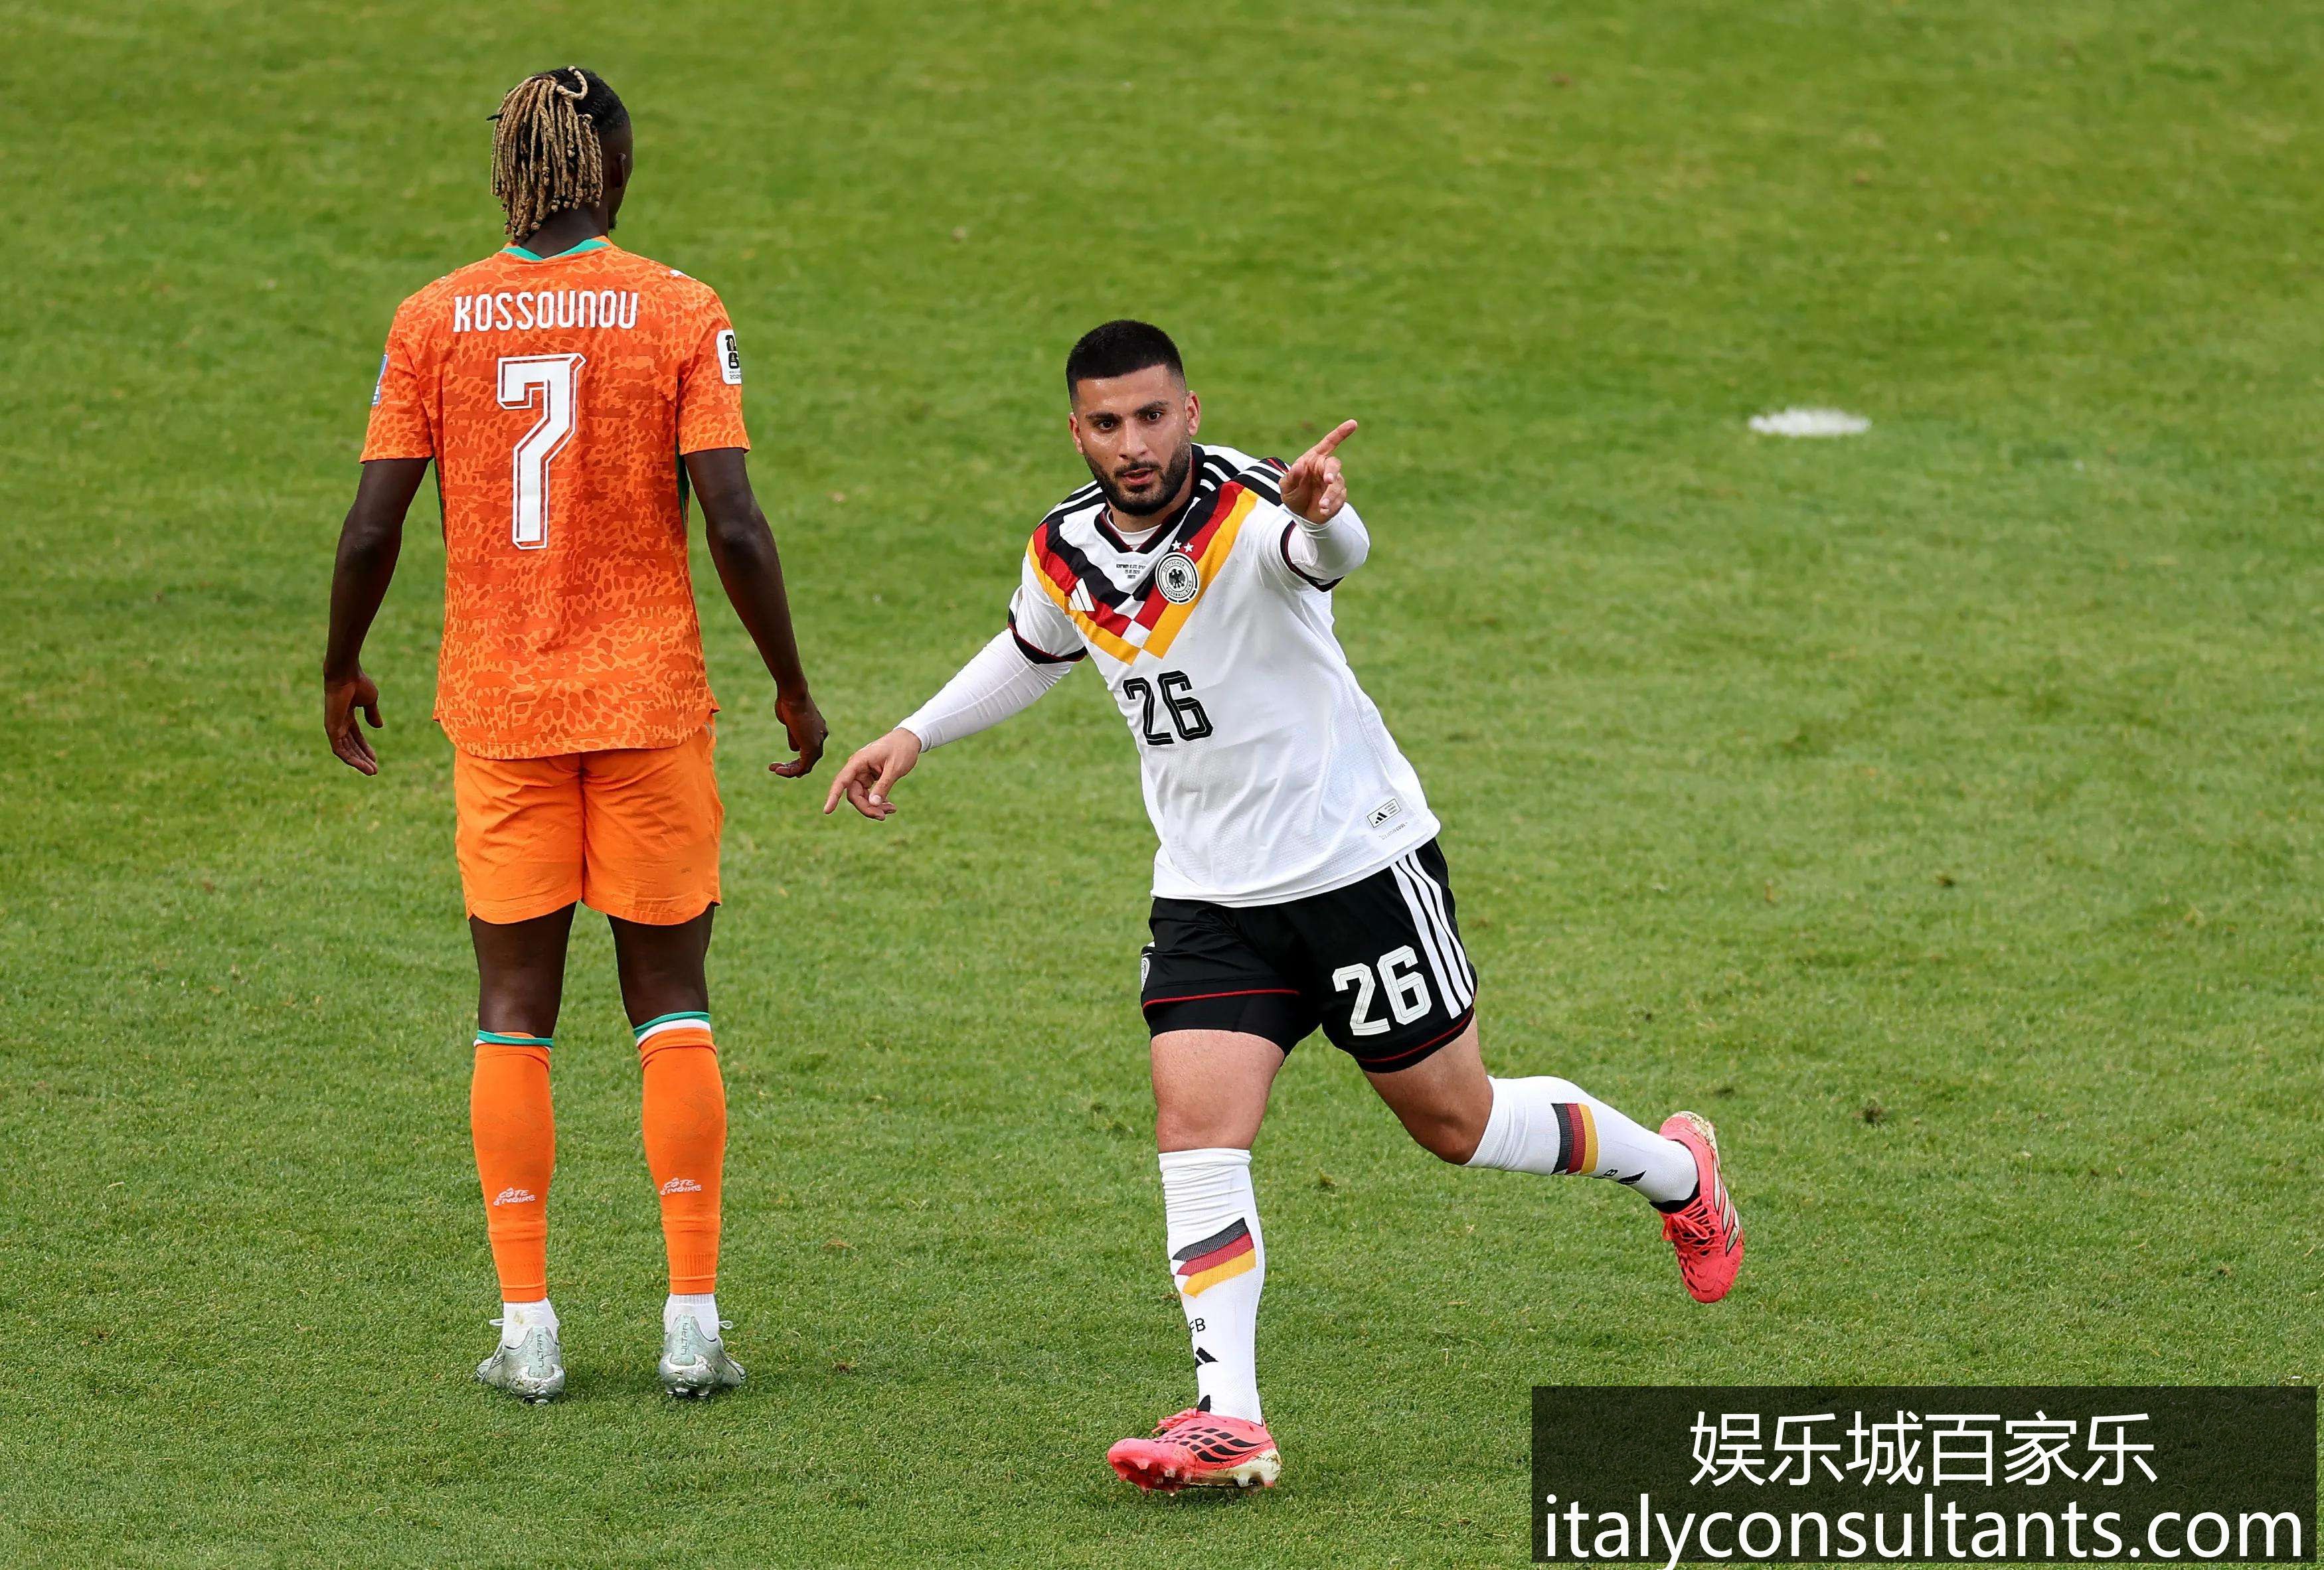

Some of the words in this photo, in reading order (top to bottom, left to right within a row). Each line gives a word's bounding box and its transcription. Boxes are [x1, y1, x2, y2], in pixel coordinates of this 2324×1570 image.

[453, 290, 639, 333] KOSSOUNOU
[497, 353, 587, 550] 7
[1122, 670, 1214, 746] 26
[1332, 945, 1432, 1036] 26
